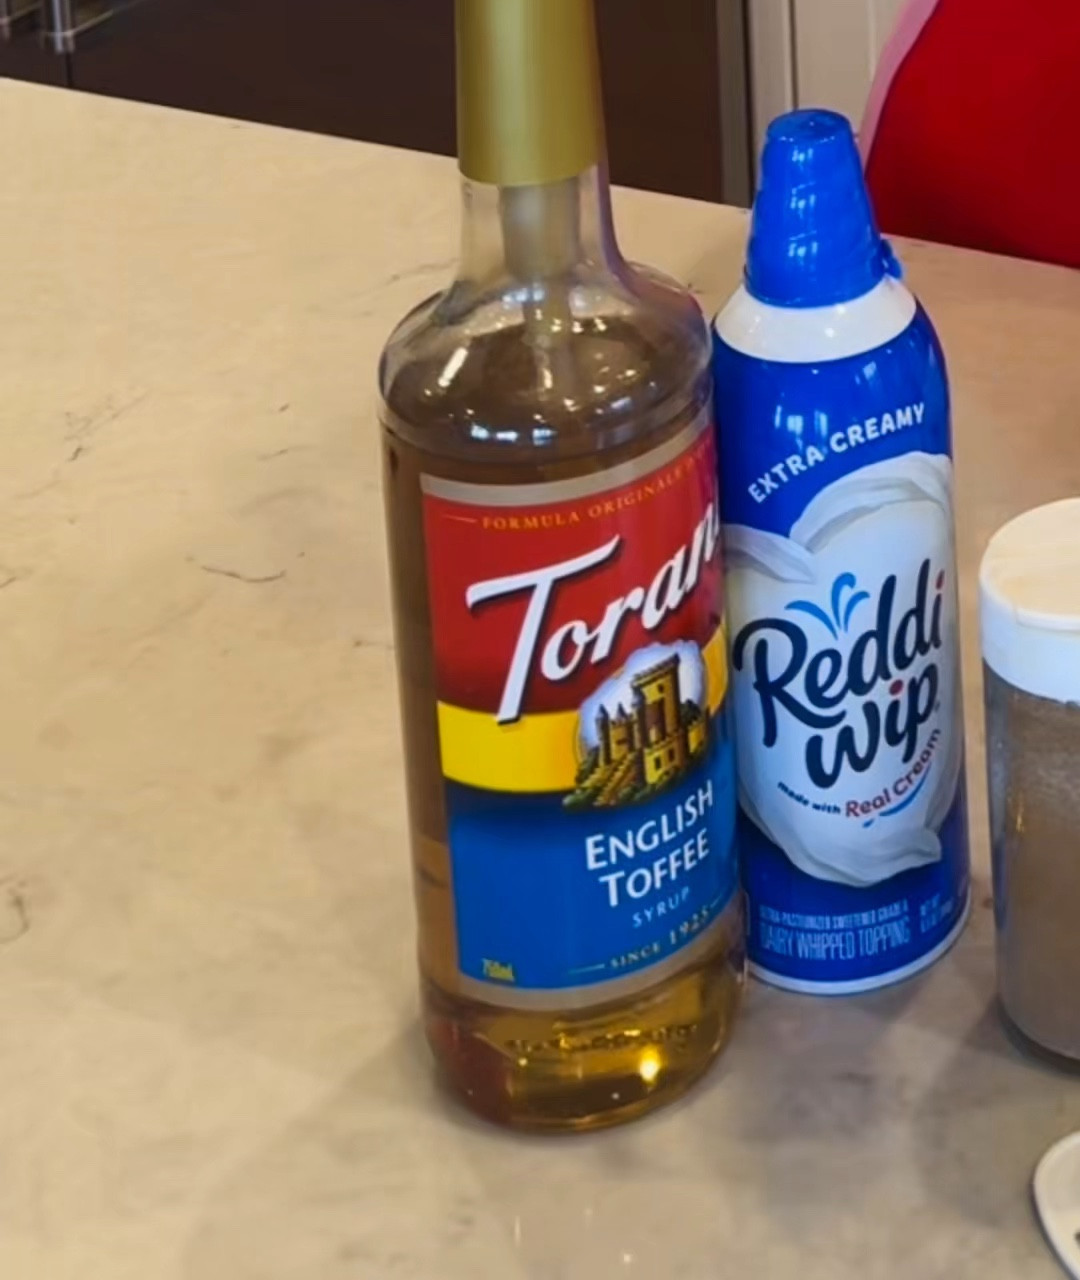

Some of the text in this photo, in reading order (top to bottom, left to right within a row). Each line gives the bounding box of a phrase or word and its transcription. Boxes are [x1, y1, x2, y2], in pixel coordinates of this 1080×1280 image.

[748, 402, 925, 503] EXTRA CREAMY
[483, 511, 579, 530] FORMULA
[732, 558, 945, 748] Reddi
[805, 663, 938, 789] wip
[777, 728, 941, 817] made with Real Cream
[586, 779, 714, 870] ENGLISH
[599, 828, 710, 907] TOFFEE
[632, 886, 689, 928] SYRUP
[611, 942, 660, 968] SINCE
[797, 930, 855, 961] WHIPPED
[858, 916, 912, 957] TOPPING
